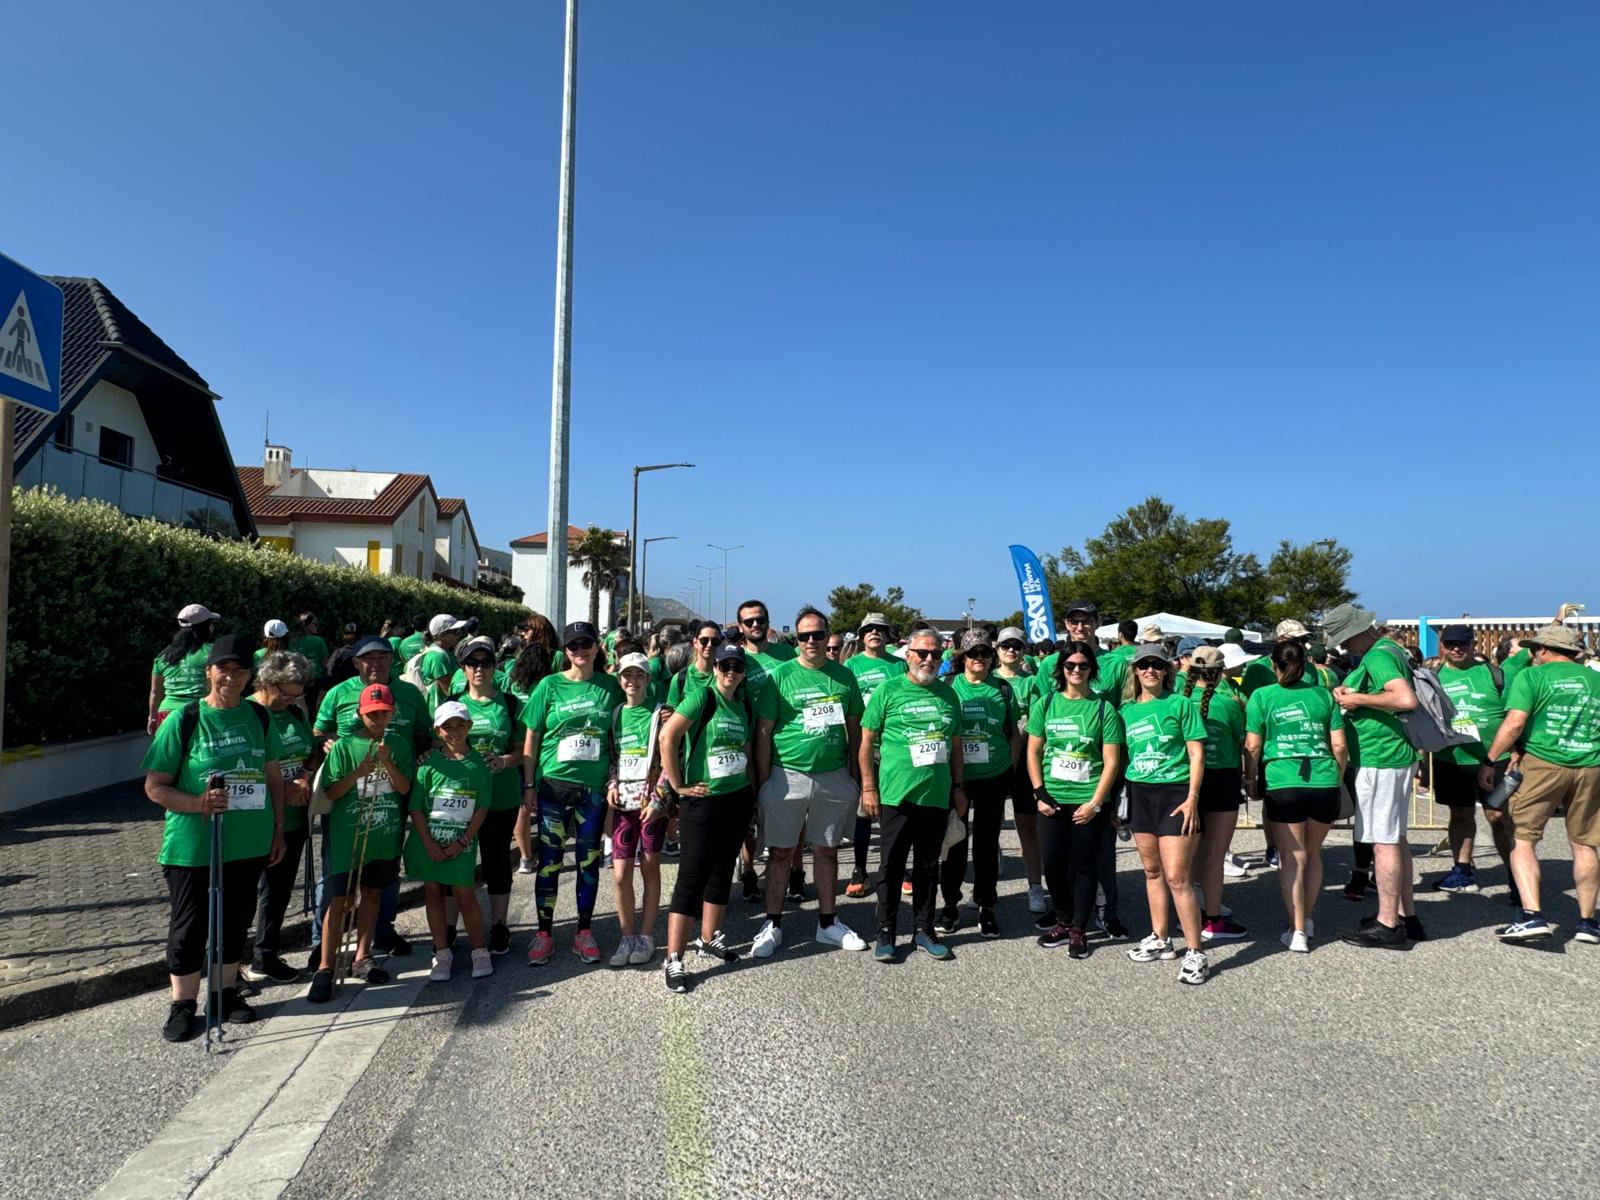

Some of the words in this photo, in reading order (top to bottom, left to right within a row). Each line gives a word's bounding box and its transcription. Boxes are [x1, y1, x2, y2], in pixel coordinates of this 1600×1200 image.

[811, 704, 834, 716] 2208
[569, 739, 591, 748] 194
[919, 742, 941, 753] 2207
[964, 743, 980, 752] 195
[620, 758, 639, 767] 197
[718, 753, 740, 765] 2191
[1060, 759, 1082, 770] 2201
[442, 798, 468, 809] 2210
